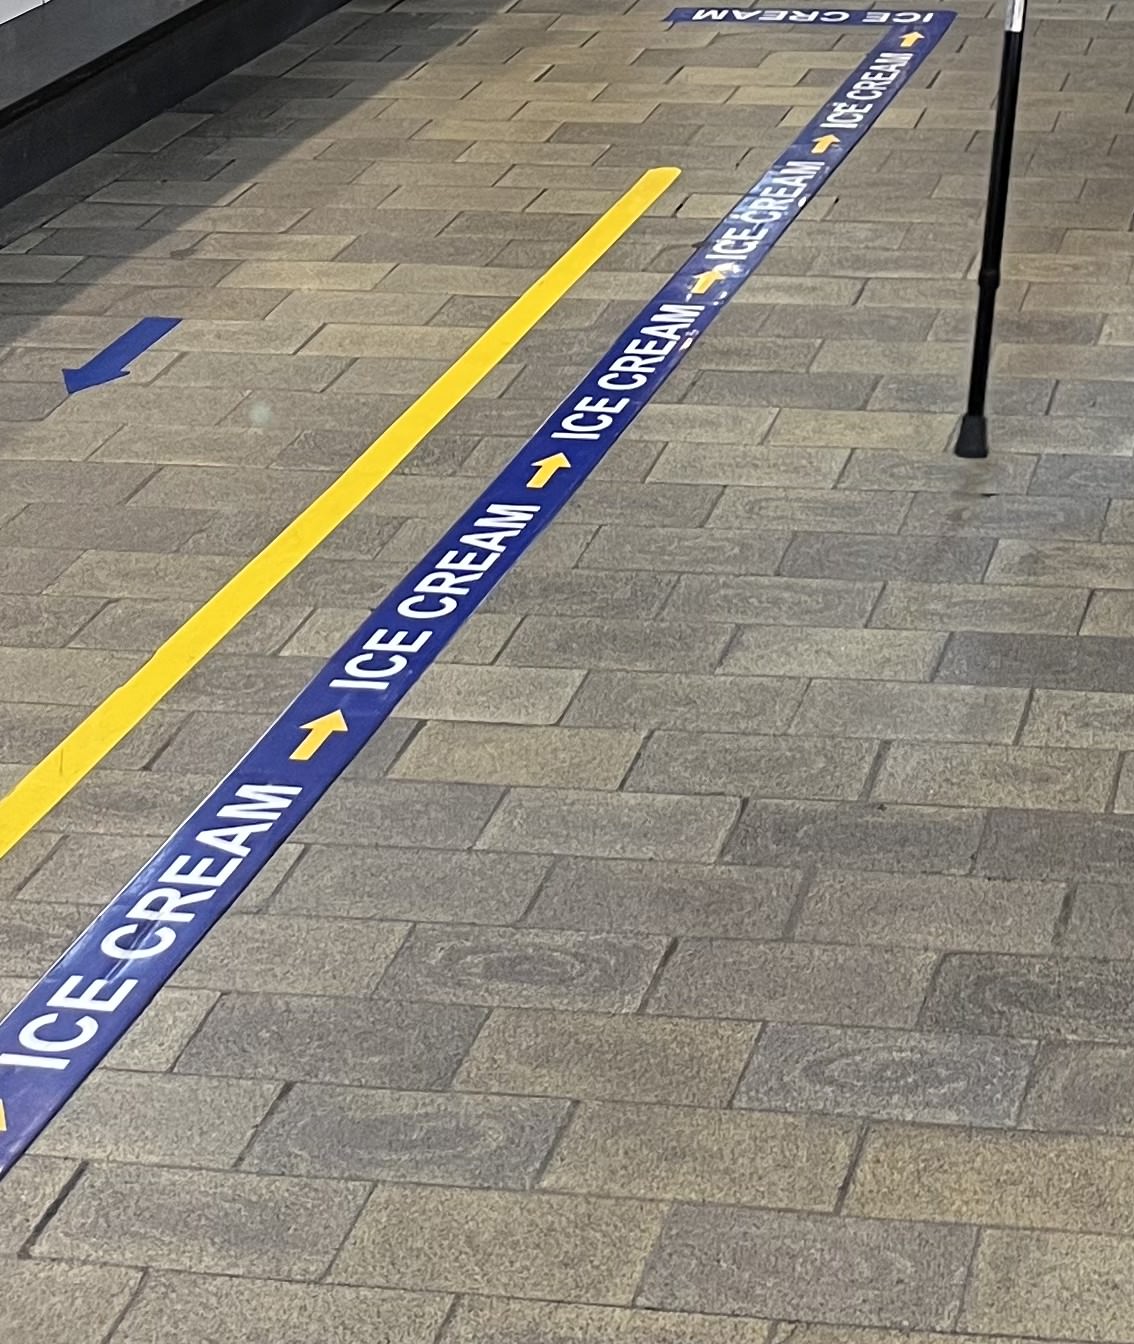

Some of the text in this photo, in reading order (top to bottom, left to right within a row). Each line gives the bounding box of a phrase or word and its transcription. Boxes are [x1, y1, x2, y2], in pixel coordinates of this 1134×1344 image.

[691, 7, 935, 24] ICE CREAM
[819, 51, 914, 129] ICE CREAM
[704, 160, 826, 261] ICE CREAM
[551, 301, 703, 442] ICE CREAM
[329, 502, 542, 692] ICE CREAM
[0, 782, 304, 1071] ICE CREAM
